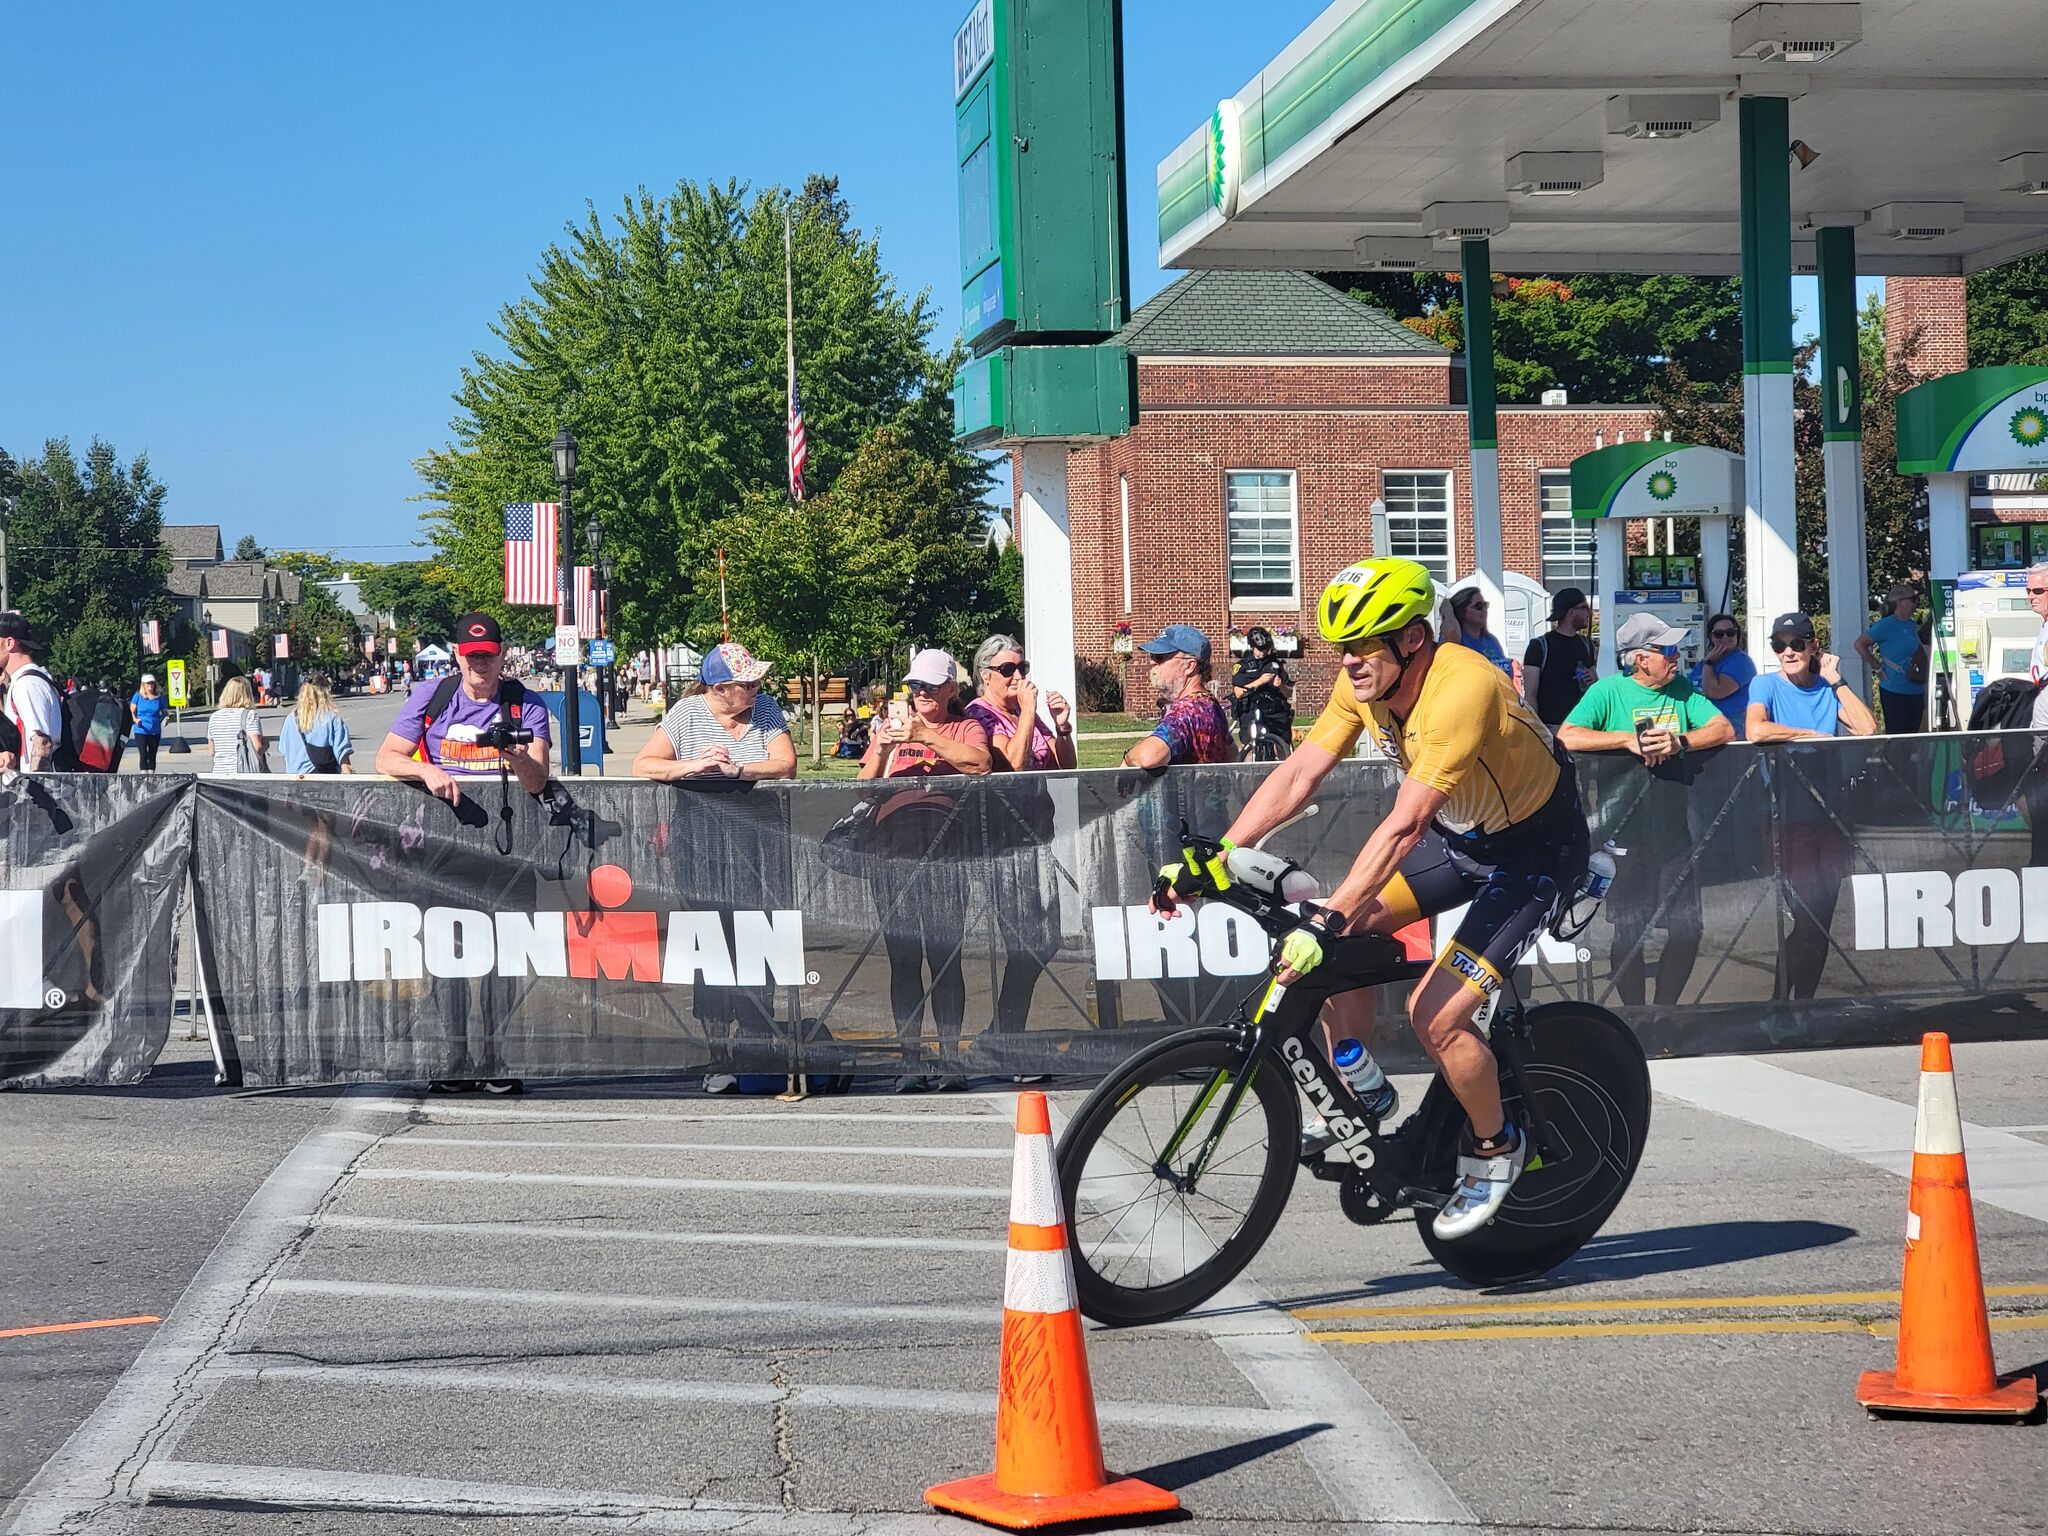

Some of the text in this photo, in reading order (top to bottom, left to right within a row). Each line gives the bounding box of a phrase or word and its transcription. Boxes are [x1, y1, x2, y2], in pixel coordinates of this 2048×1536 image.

[1665, 459, 1678, 469] bp
[1712, 505, 1719, 514] 3
[1337, 571, 1363, 583] 1216
[1942, 585, 1954, 632] diesel
[558, 637, 575, 648] NO
[1451, 950, 1486, 982] TRI
